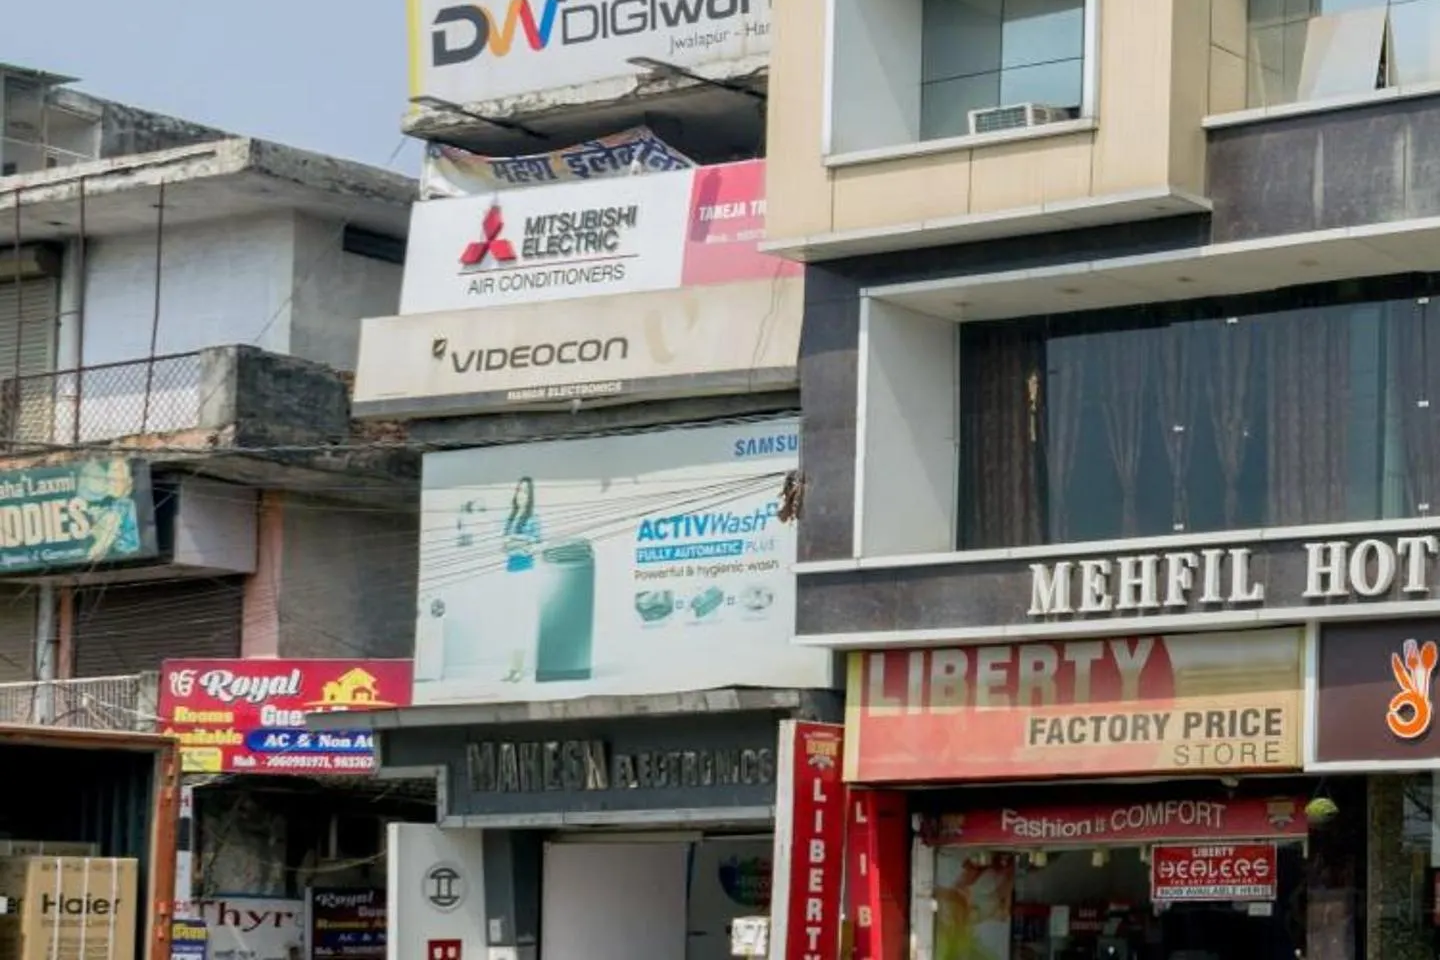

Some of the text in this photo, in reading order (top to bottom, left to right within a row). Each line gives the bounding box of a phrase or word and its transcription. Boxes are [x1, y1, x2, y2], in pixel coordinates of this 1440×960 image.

[524, 204, 640, 235] MITSUBISHI
[521, 229, 621, 259] ELECTRIC
[467, 263, 626, 296] AIR CONDITIONERS
[633, 566, 684, 581] Powerful
[698, 563, 745, 578] hygienic
[747, 559, 780, 571] wash
[1027, 547, 1265, 616] MEHFIL
[199, 668, 302, 703] Royal
[867, 638, 1157, 719] LIBERTY
[260, 704, 312, 728] Gue
[1028, 706, 1283, 746] FACTORY PRICE
[263, 734, 290, 748] AC
[318, 734, 351, 749] Non
[1172, 739, 1282, 767] STORE
[1001, 807, 1092, 839] Fashion
[1110, 799, 1228, 832] COMFORT
[1191, 846, 1236, 858] LIBERTY
[854, 800, 873, 960] LIB
[1158, 857, 1270, 880] HEALERS
[41, 891, 121, 915] Haier
